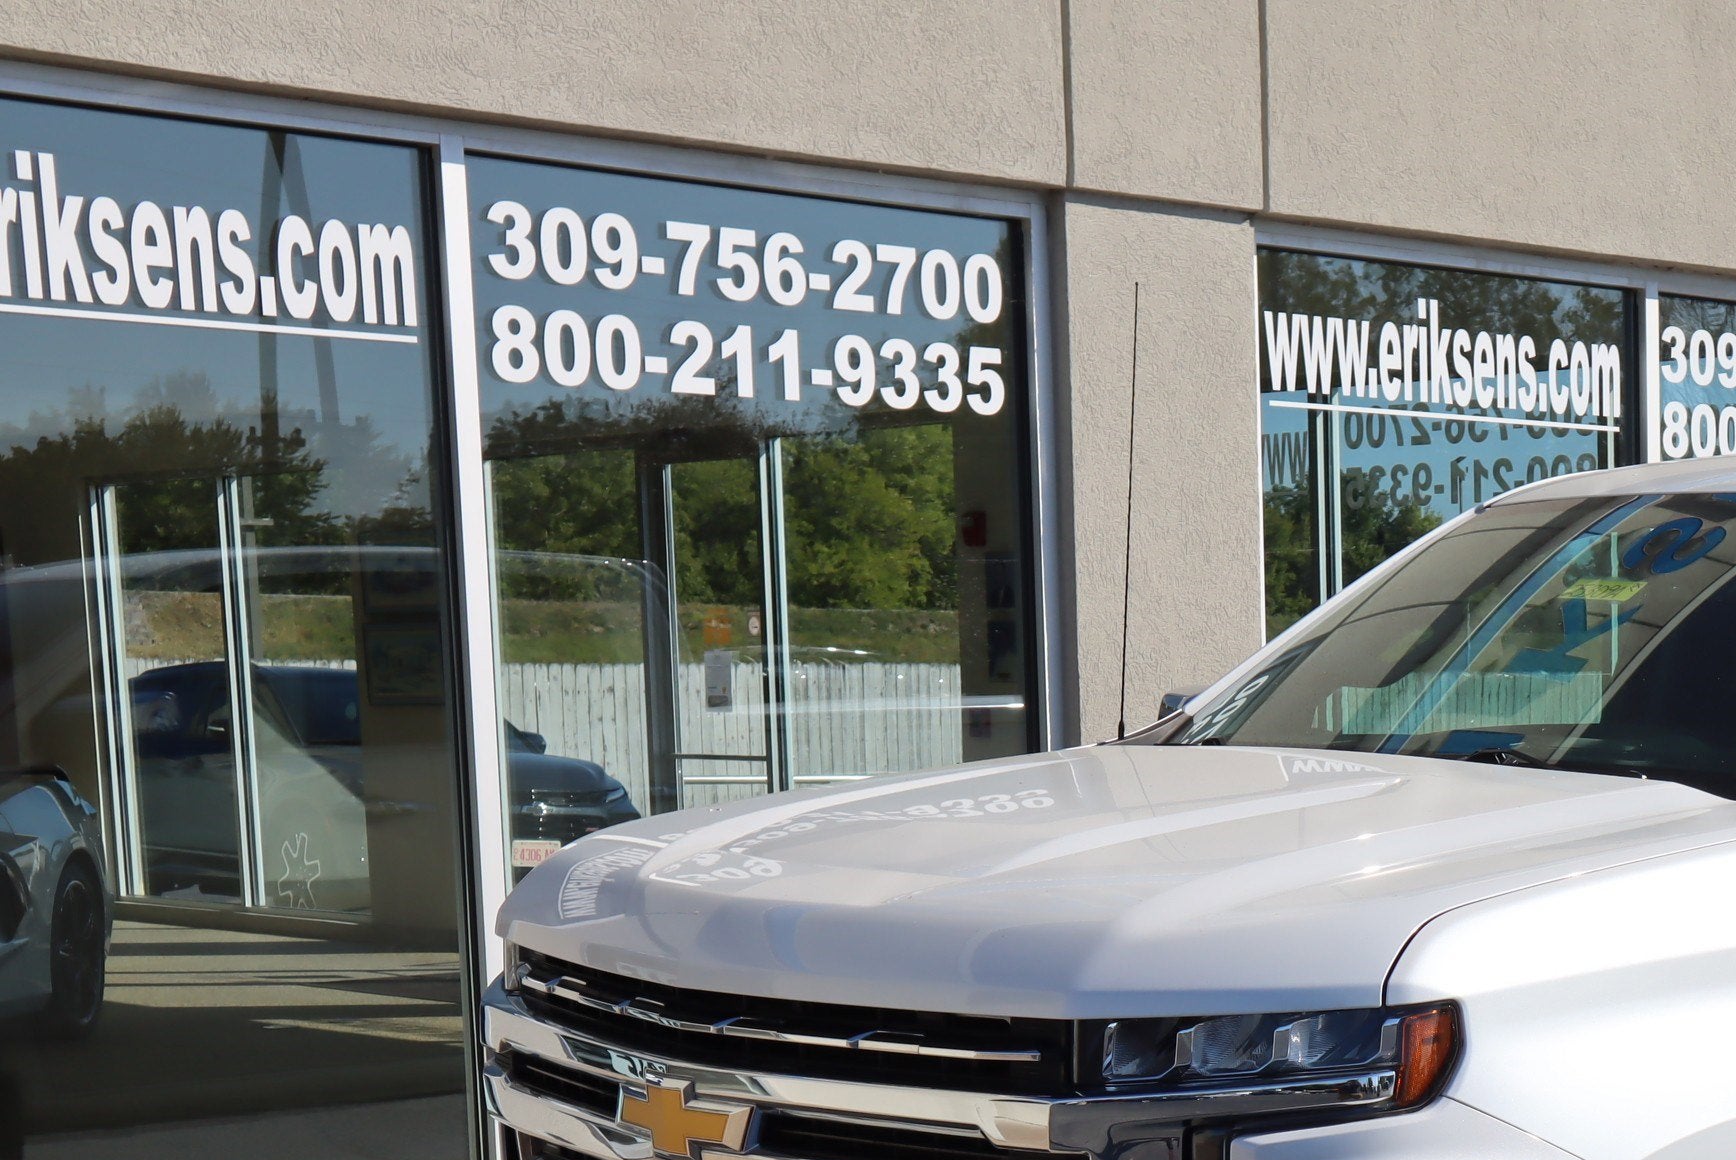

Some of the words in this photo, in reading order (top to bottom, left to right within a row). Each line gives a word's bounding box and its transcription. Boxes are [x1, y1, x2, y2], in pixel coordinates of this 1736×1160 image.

[486, 200, 1003, 324] 309-756-2700
[490, 304, 1006, 416] 800-211-9335
[1263, 297, 1621, 418] www.eriksens.com
